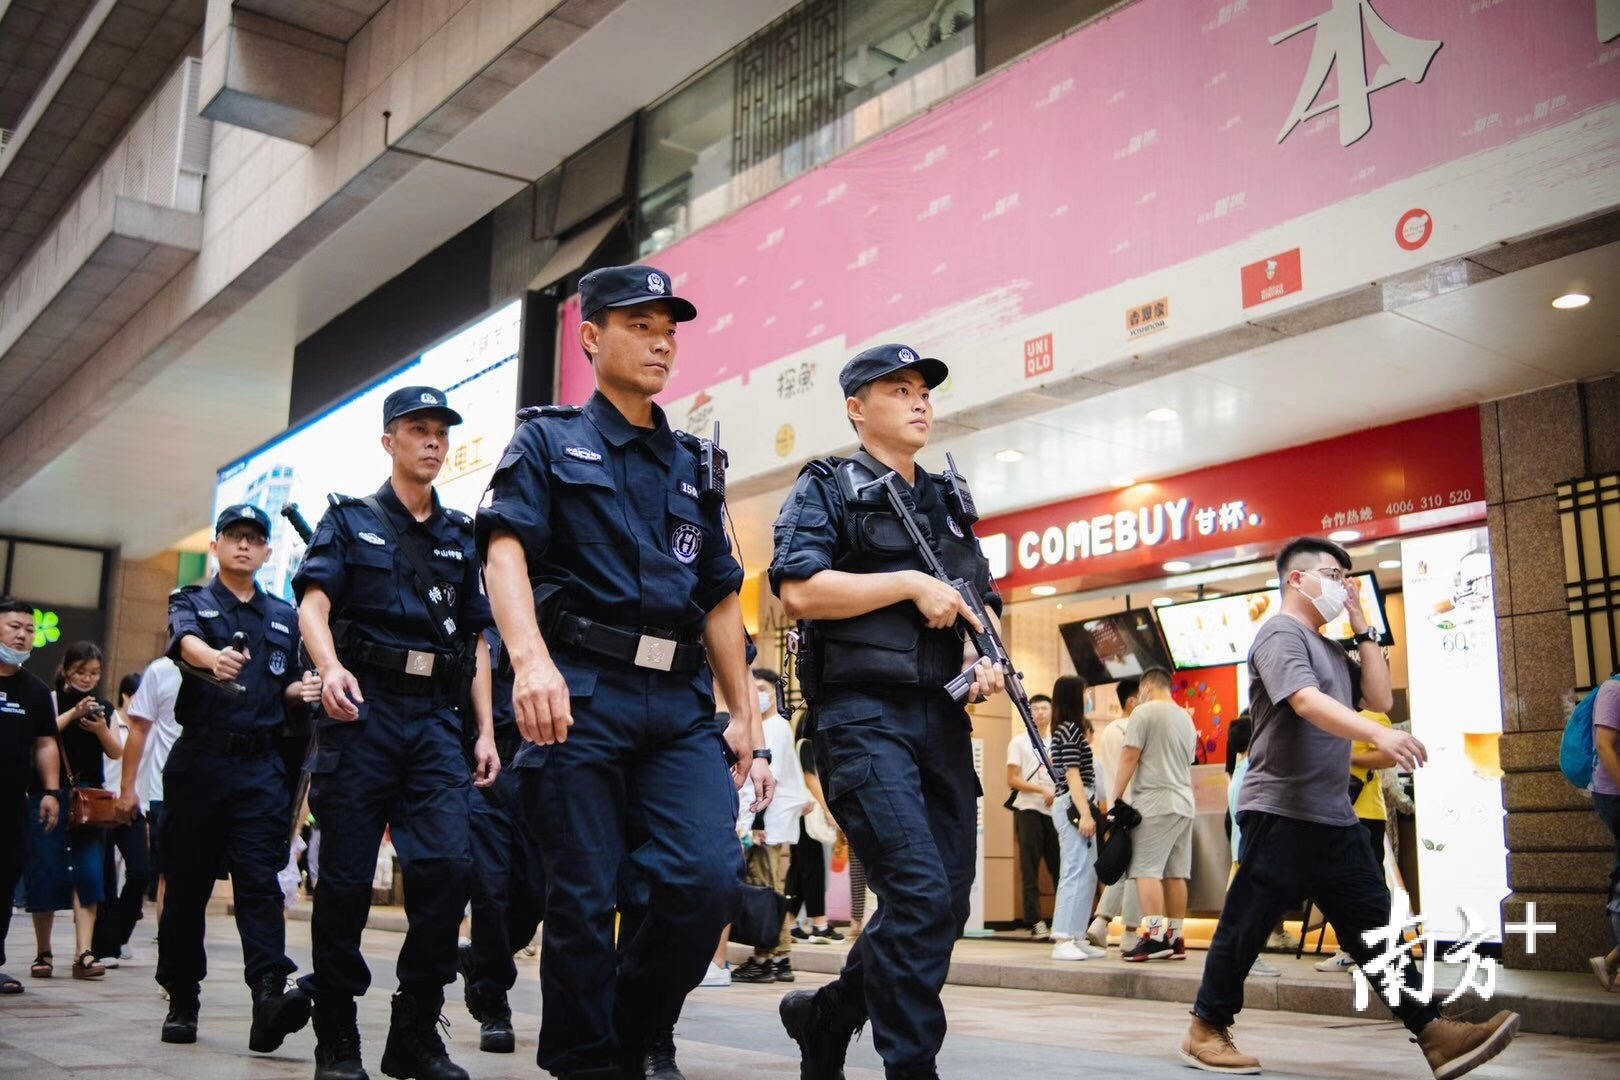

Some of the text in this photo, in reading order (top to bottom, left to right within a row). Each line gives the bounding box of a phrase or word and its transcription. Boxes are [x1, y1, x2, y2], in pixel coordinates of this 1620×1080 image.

[1027, 337, 1049, 357] UNI
[1028, 353, 1051, 375] QLO
[1321, 489, 1472, 529] 合作热线 4006 310 520
[1018, 498, 1190, 570] COMEBUY
